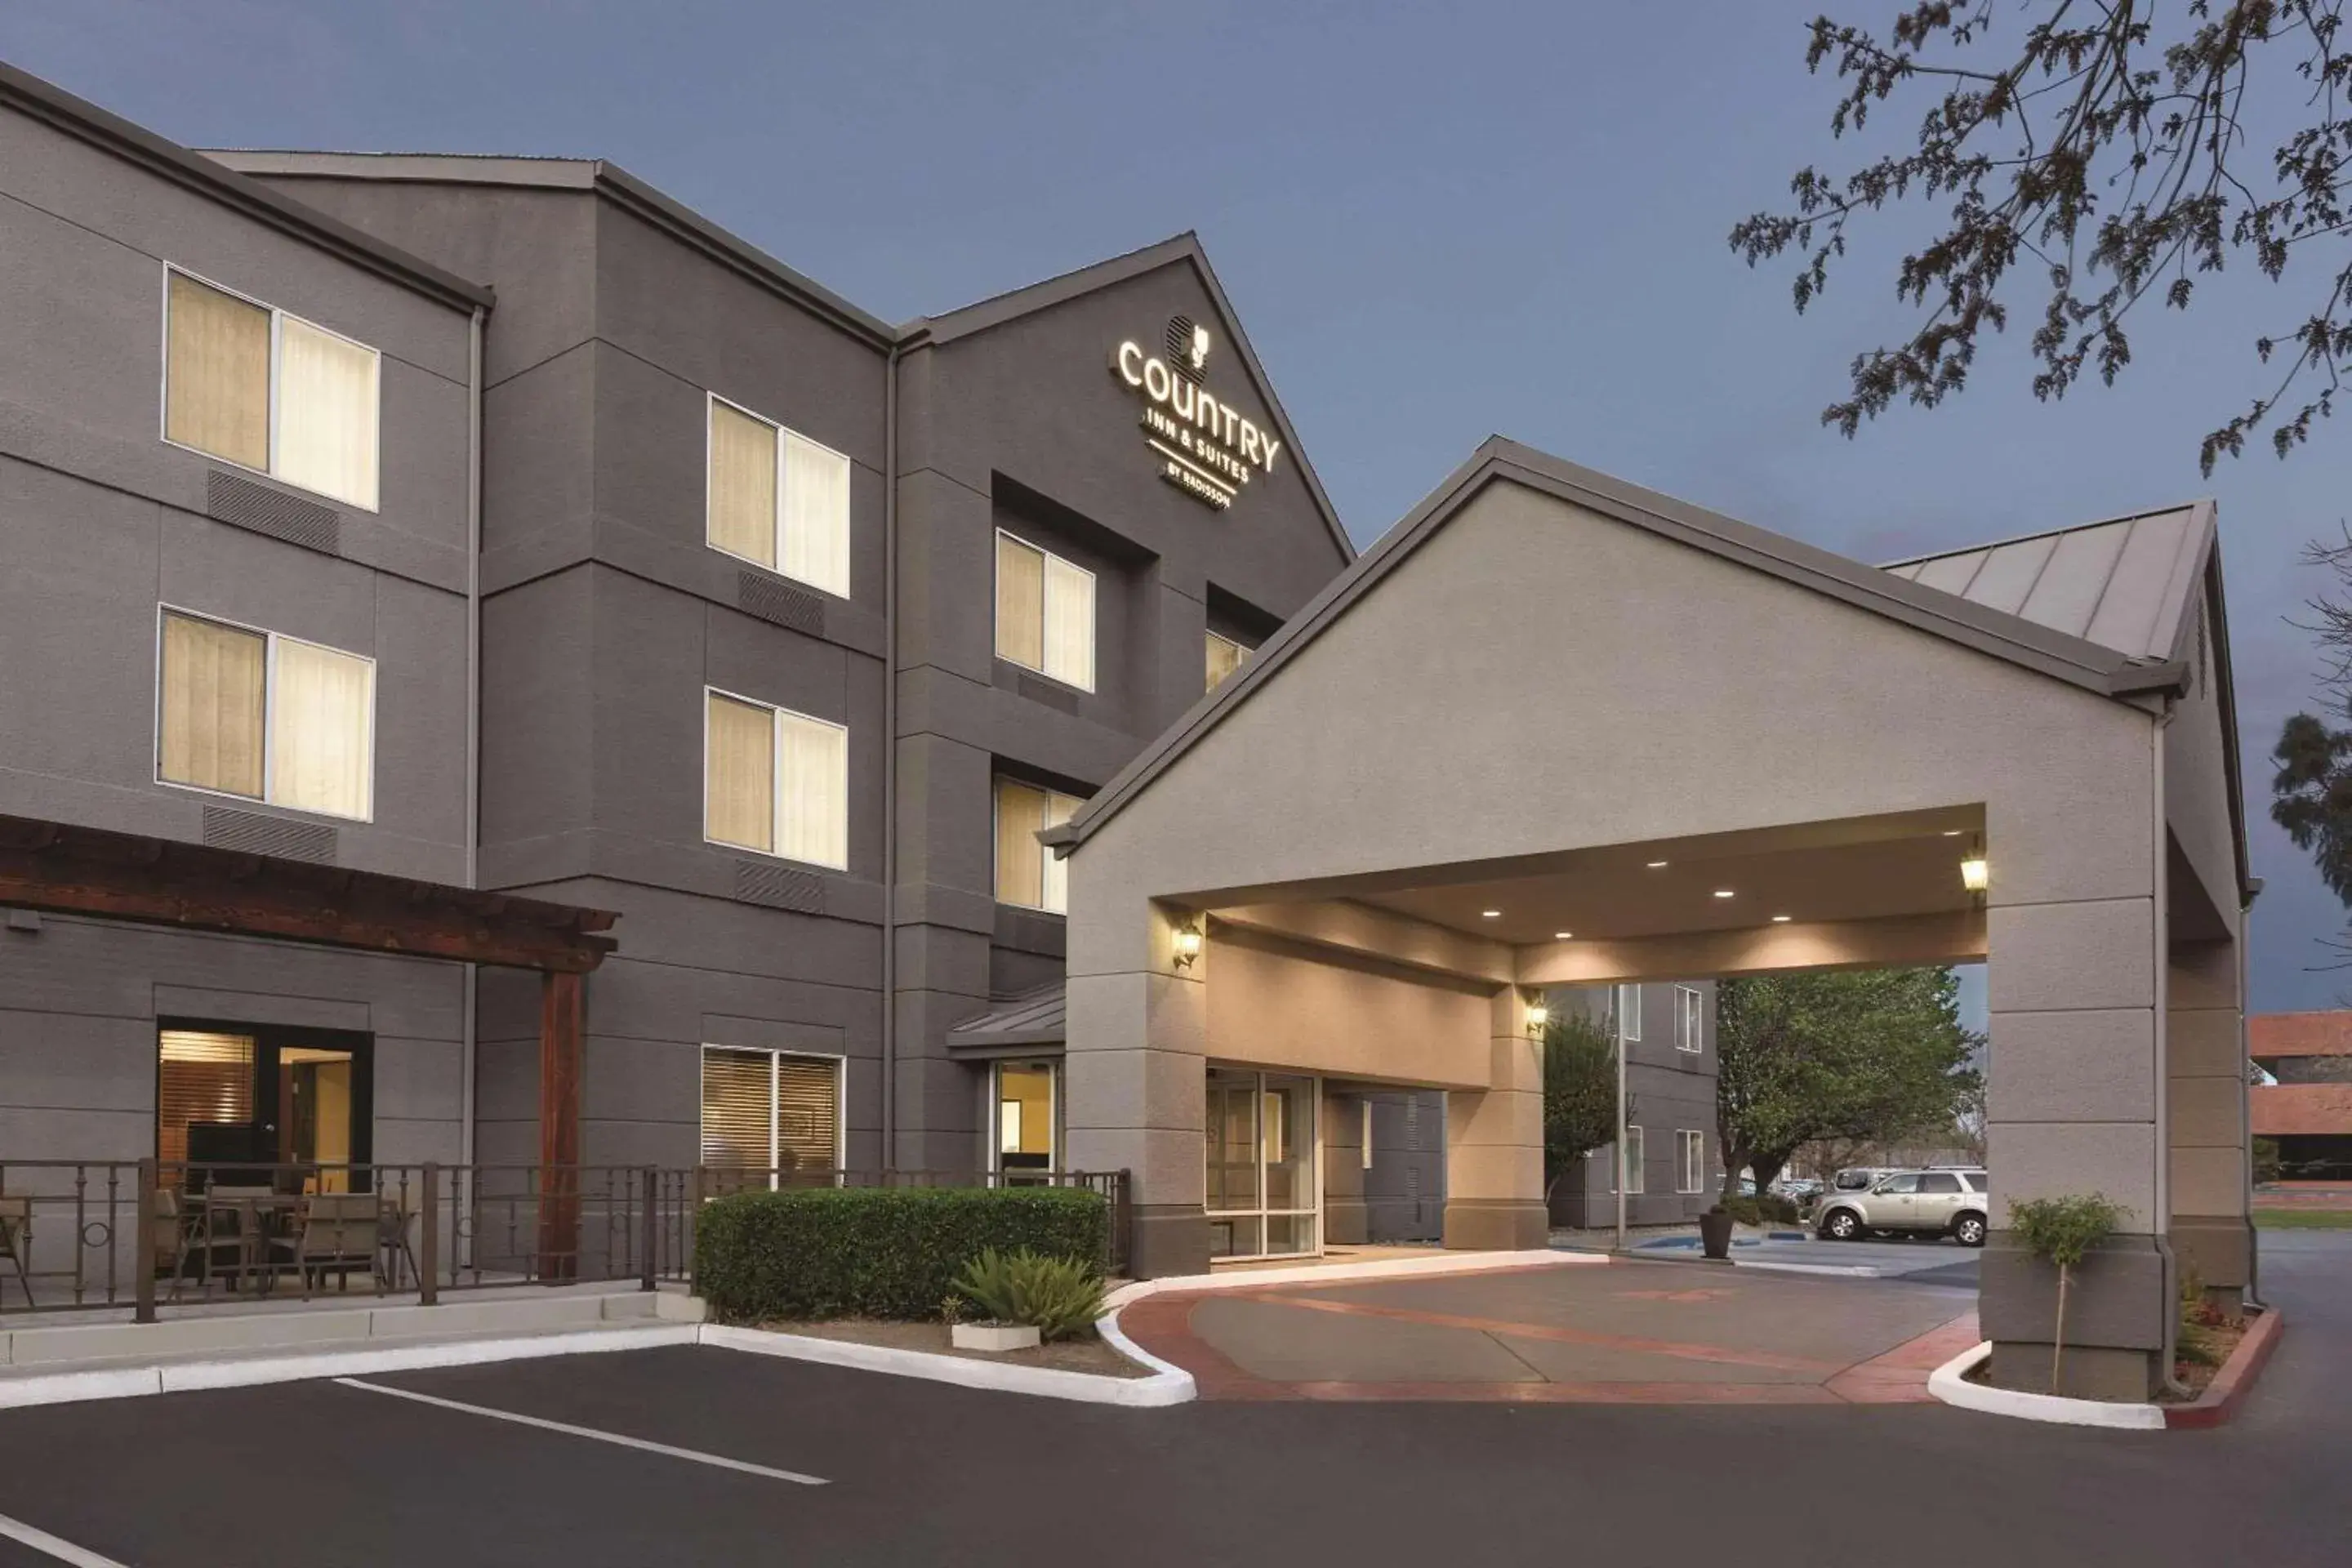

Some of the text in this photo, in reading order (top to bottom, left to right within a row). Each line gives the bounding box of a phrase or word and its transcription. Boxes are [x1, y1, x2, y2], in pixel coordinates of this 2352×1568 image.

[1147, 408, 1249, 483] INN & SUITES
[1167, 461, 1231, 508] BY RADISSON
